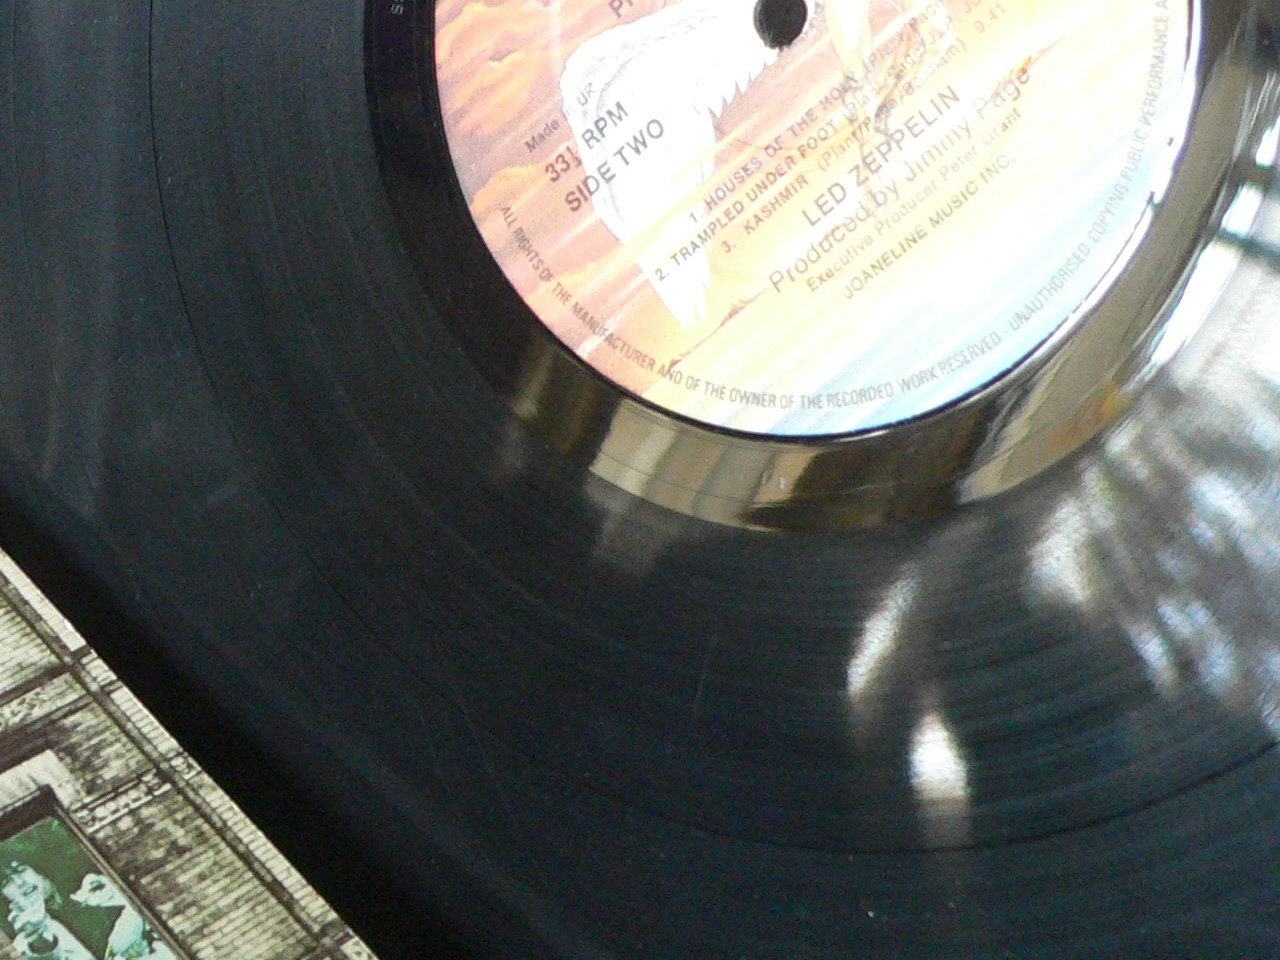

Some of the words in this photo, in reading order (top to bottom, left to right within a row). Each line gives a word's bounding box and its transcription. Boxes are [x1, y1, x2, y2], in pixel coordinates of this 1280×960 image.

[524, 118, 560, 151] Made
[575, 83, 597, 106] UK
[563, 162, 616, 211] SIDE
[614, 118, 665, 166] TWO
[580, 102, 628, 148] RPM
[703, 156, 762, 209] HOUSES
[764, 135, 786, 158] OF
[787, 108, 817, 137] THE
[768, 201, 870, 293] Produced
[870, 176, 902, 210] by
[900, 115, 974, 184] Jimmy
[973, 64, 1033, 122] Page
[801, 180, 848, 225] LED
[848, 86, 960, 185] ZEPPELIN
[500, 206, 517, 229] ALL
[551, 282, 572, 306] THE
[572, 301, 657, 371] MANUFACTURER
[658, 363, 684, 385] AND
[685, 375, 701, 390] OF
[704, 381, 727, 401] THE
[729, 385, 778, 409] OWNER
[779, 394, 796, 409] OF
[800, 394, 824, 410] THE
[826, 382, 895, 409] RECORDED
[896, 365, 940, 394] WORK
[937, 331, 1002, 376] RESERVED
[1007, 242, 1092, 331] UNAUTHORISED
[1086, 182, 1129, 243] COPYING
[1120, 127, 1150, 182] PUBLIC
[654, 266, 667, 280] 2.
[670, 200, 745, 265] TRAMPLED
[745, 155, 796, 202] UNDER
[797, 119, 838, 158] FOOT
[721, 238, 734, 253] 3.
[741, 174, 808, 233] KASHMIR
[806, 232, 873, 292] Executive
[873, 178, 937, 235] Producer
[939, 144, 978, 180] Peter
[980, 107, 1021, 145] Grant
[841, 224, 927, 299] JOANELINE
[927, 180, 978, 227] MUSIC
[979, 150, 1014, 184] INC.
